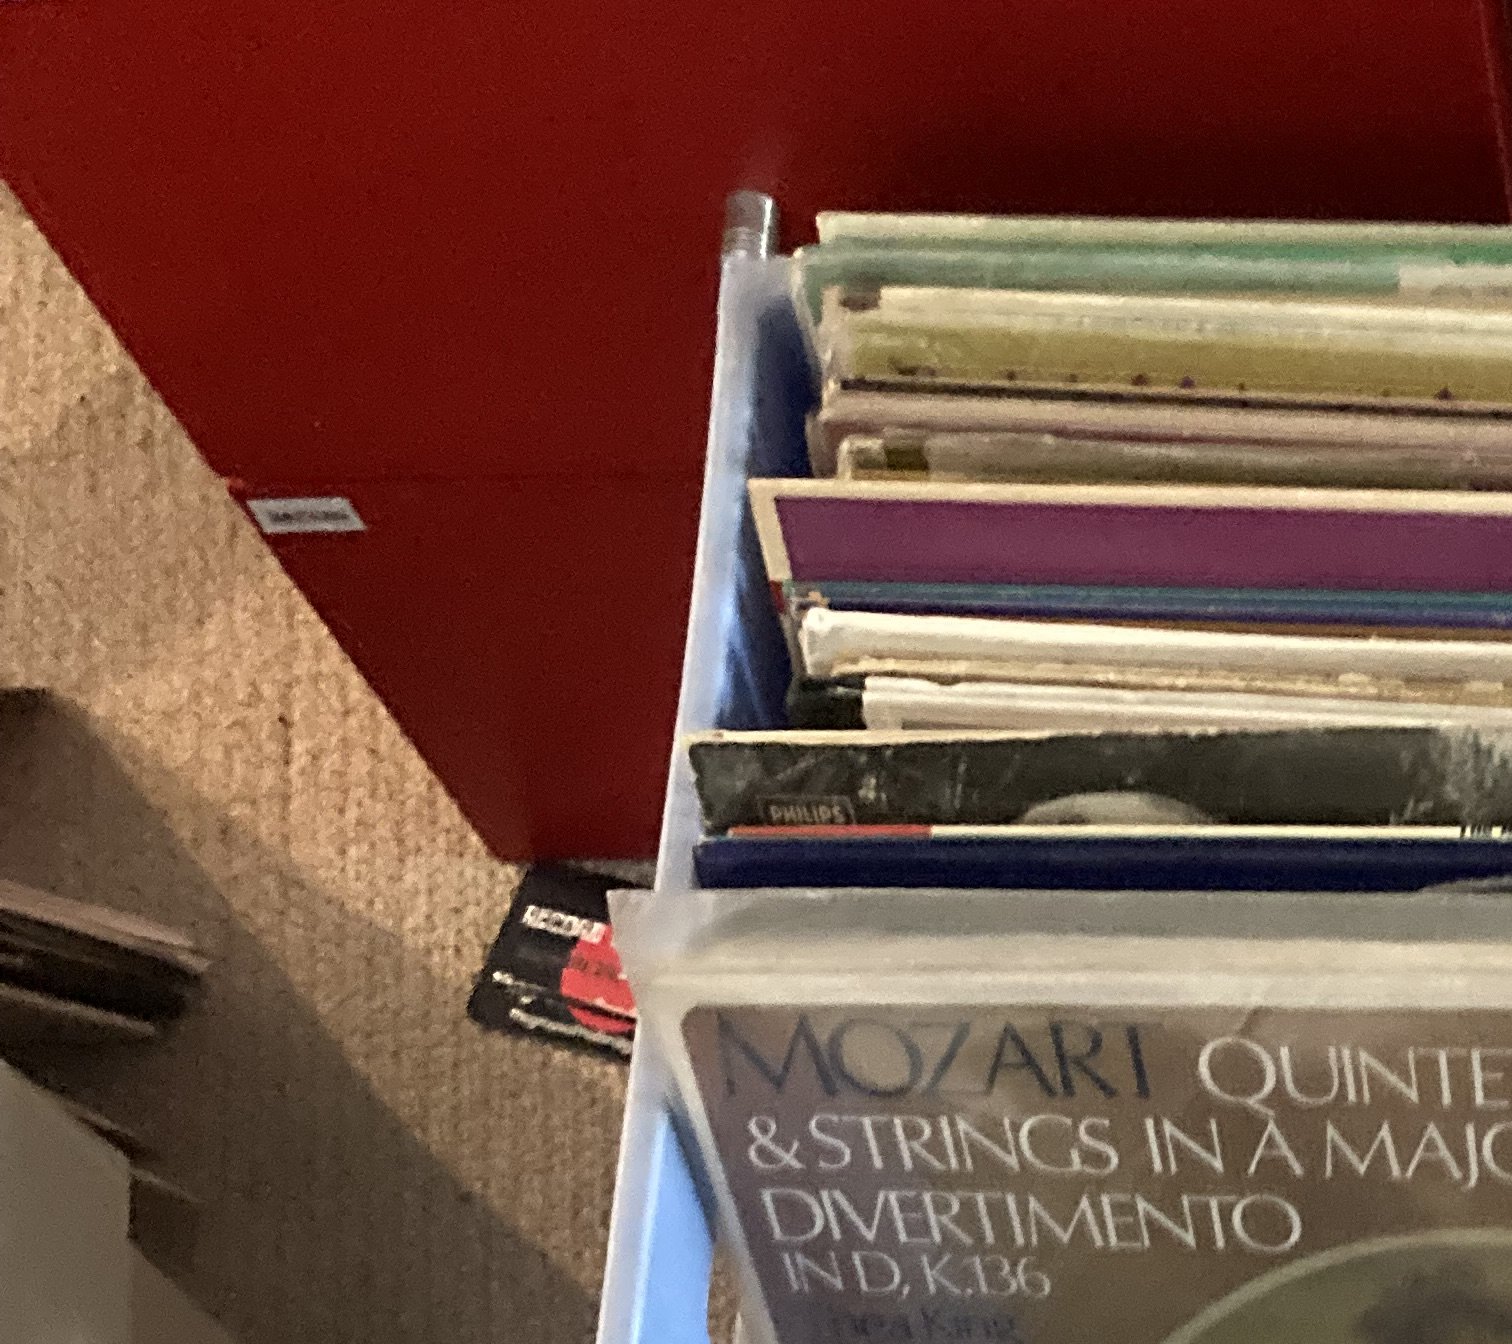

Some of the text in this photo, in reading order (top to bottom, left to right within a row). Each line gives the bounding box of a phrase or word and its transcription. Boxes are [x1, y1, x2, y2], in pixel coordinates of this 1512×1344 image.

[716, 1012, 1166, 1099] MOZART
[746, 1114, 808, 1172] &
[808, 1112, 1119, 1178] STRINGS
[1144, 1117, 1225, 1178] IN
[1246, 1118, 1309, 1179] A
[758, 1185, 1306, 1254] DIVERTIMENTO
